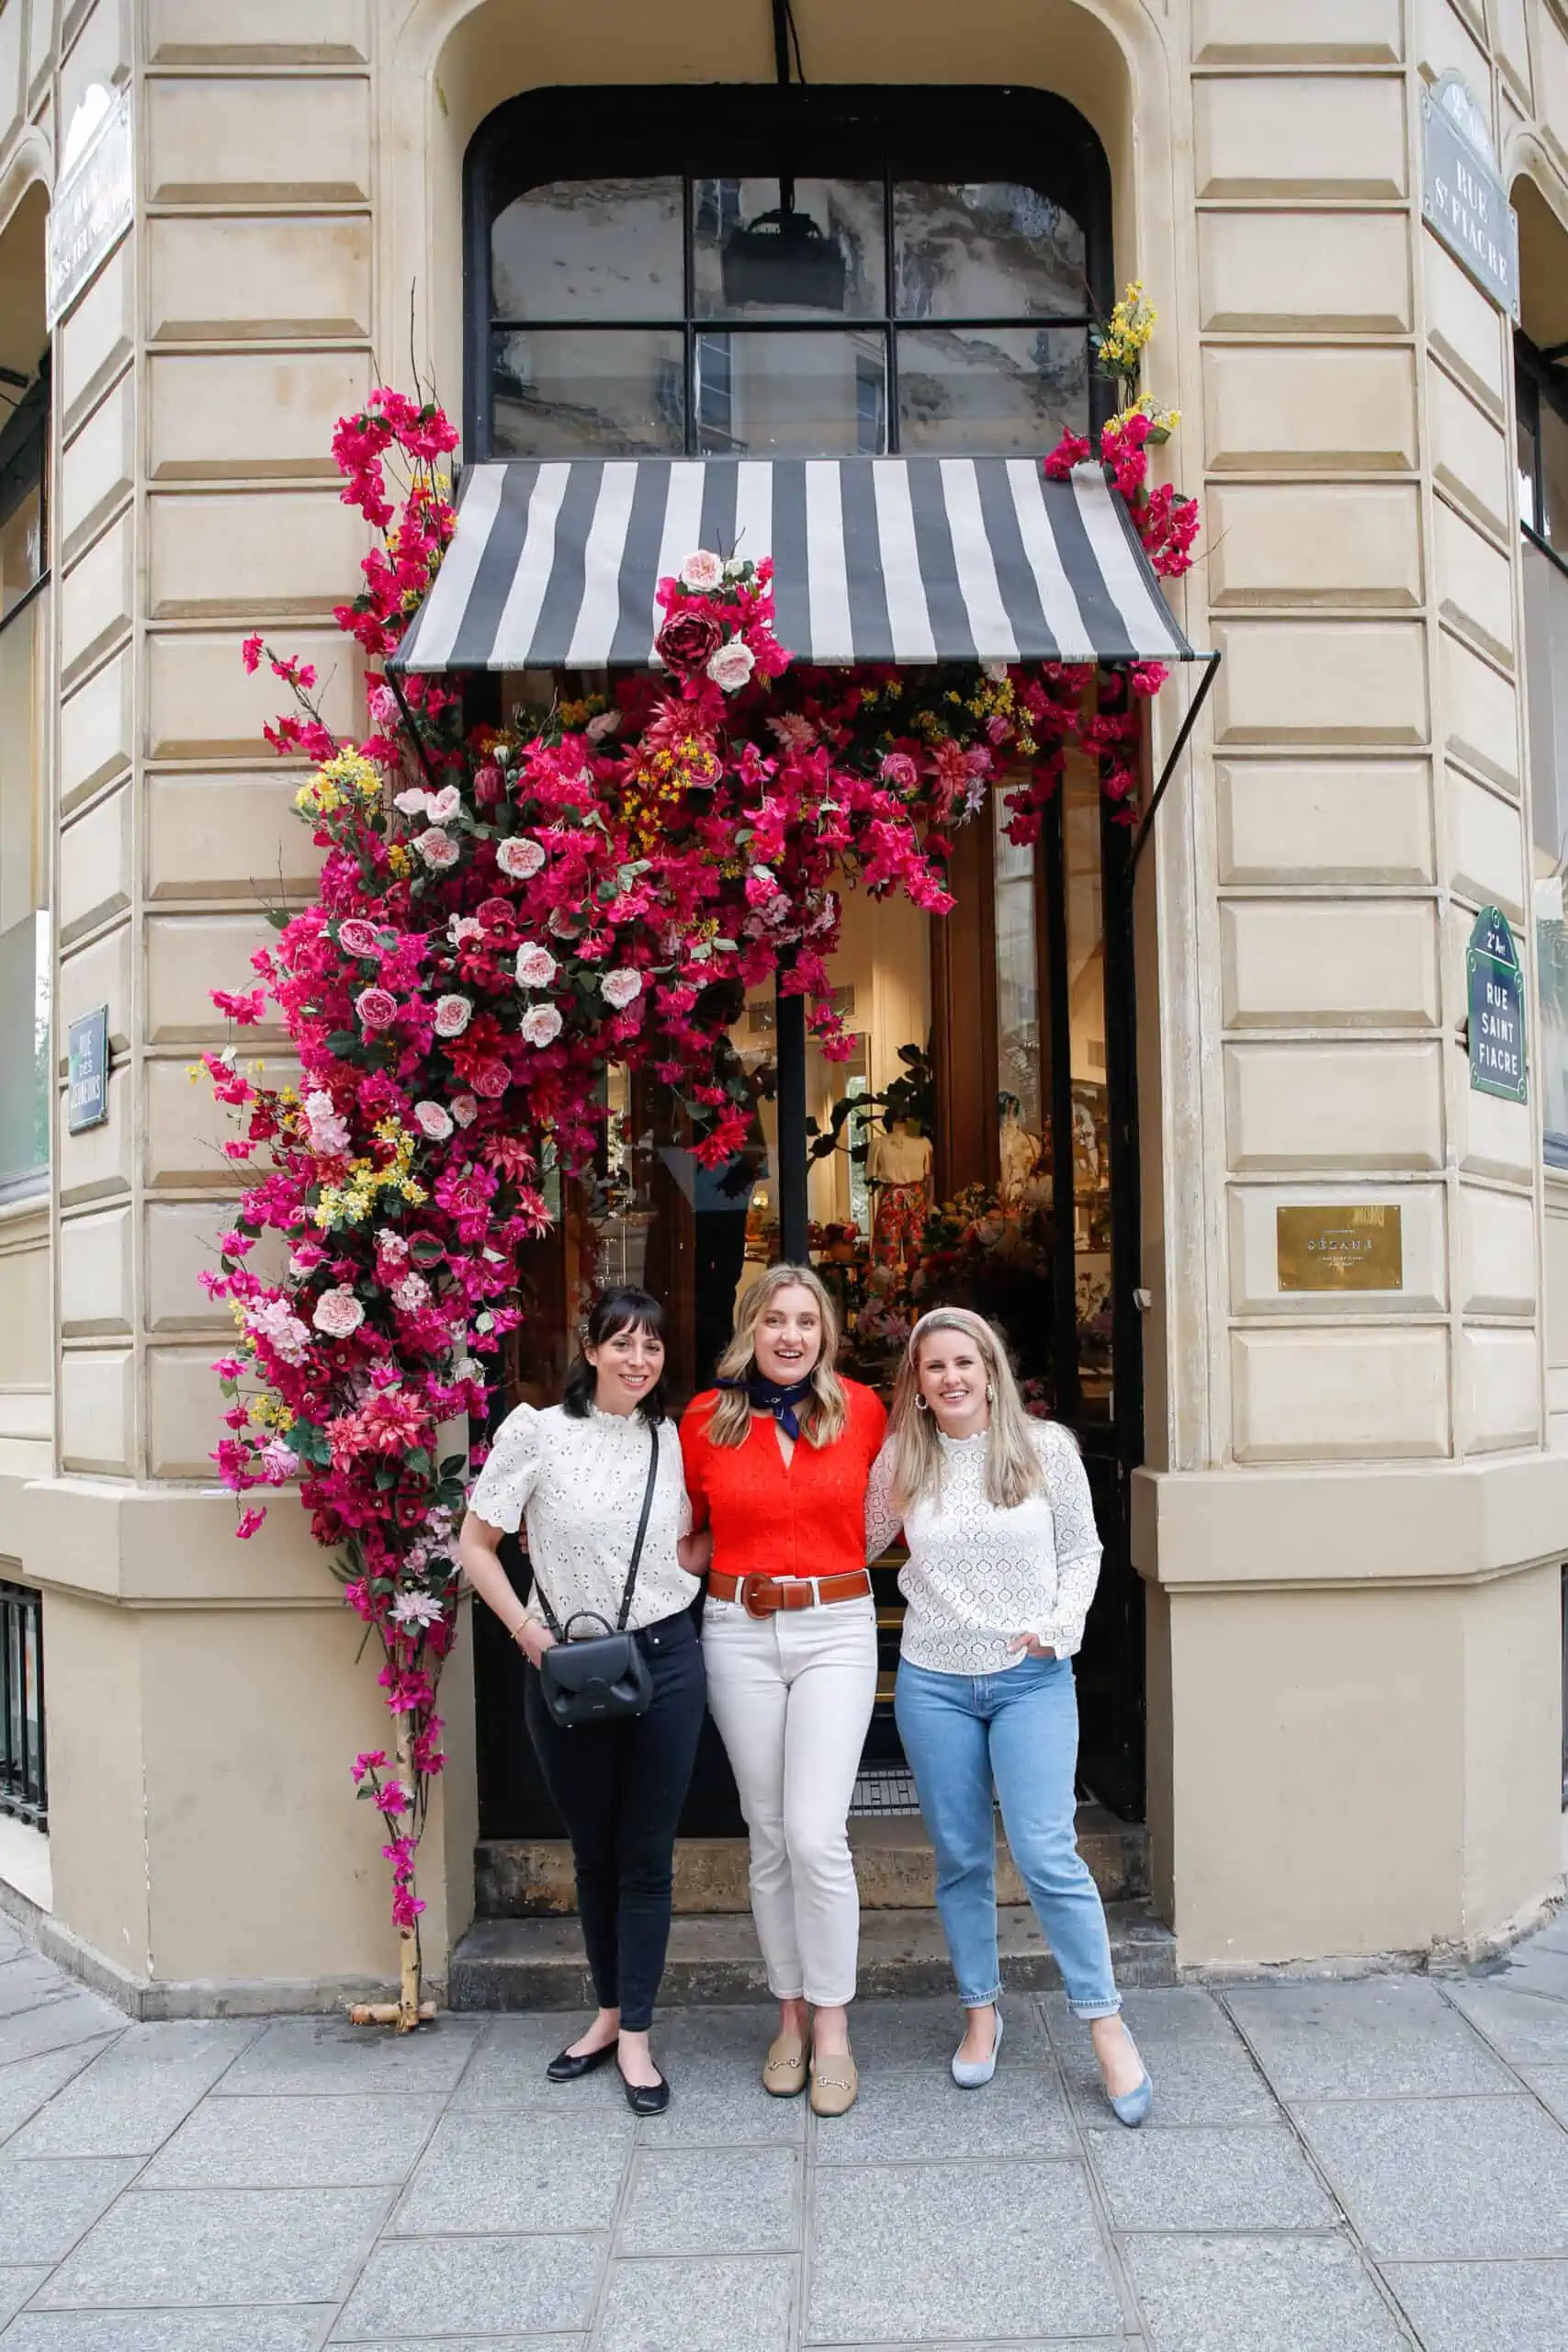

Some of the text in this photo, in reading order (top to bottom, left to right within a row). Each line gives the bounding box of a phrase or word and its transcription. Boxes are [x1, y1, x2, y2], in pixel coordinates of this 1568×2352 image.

[1456, 158, 1488, 224] RUE
[1451, 195, 1507, 286] FIACRE
[1486, 982, 1507, 1011] RUE
[1481, 1012, 1514, 1044] SAINT
[1478, 1042, 1517, 1075] FIACRE
